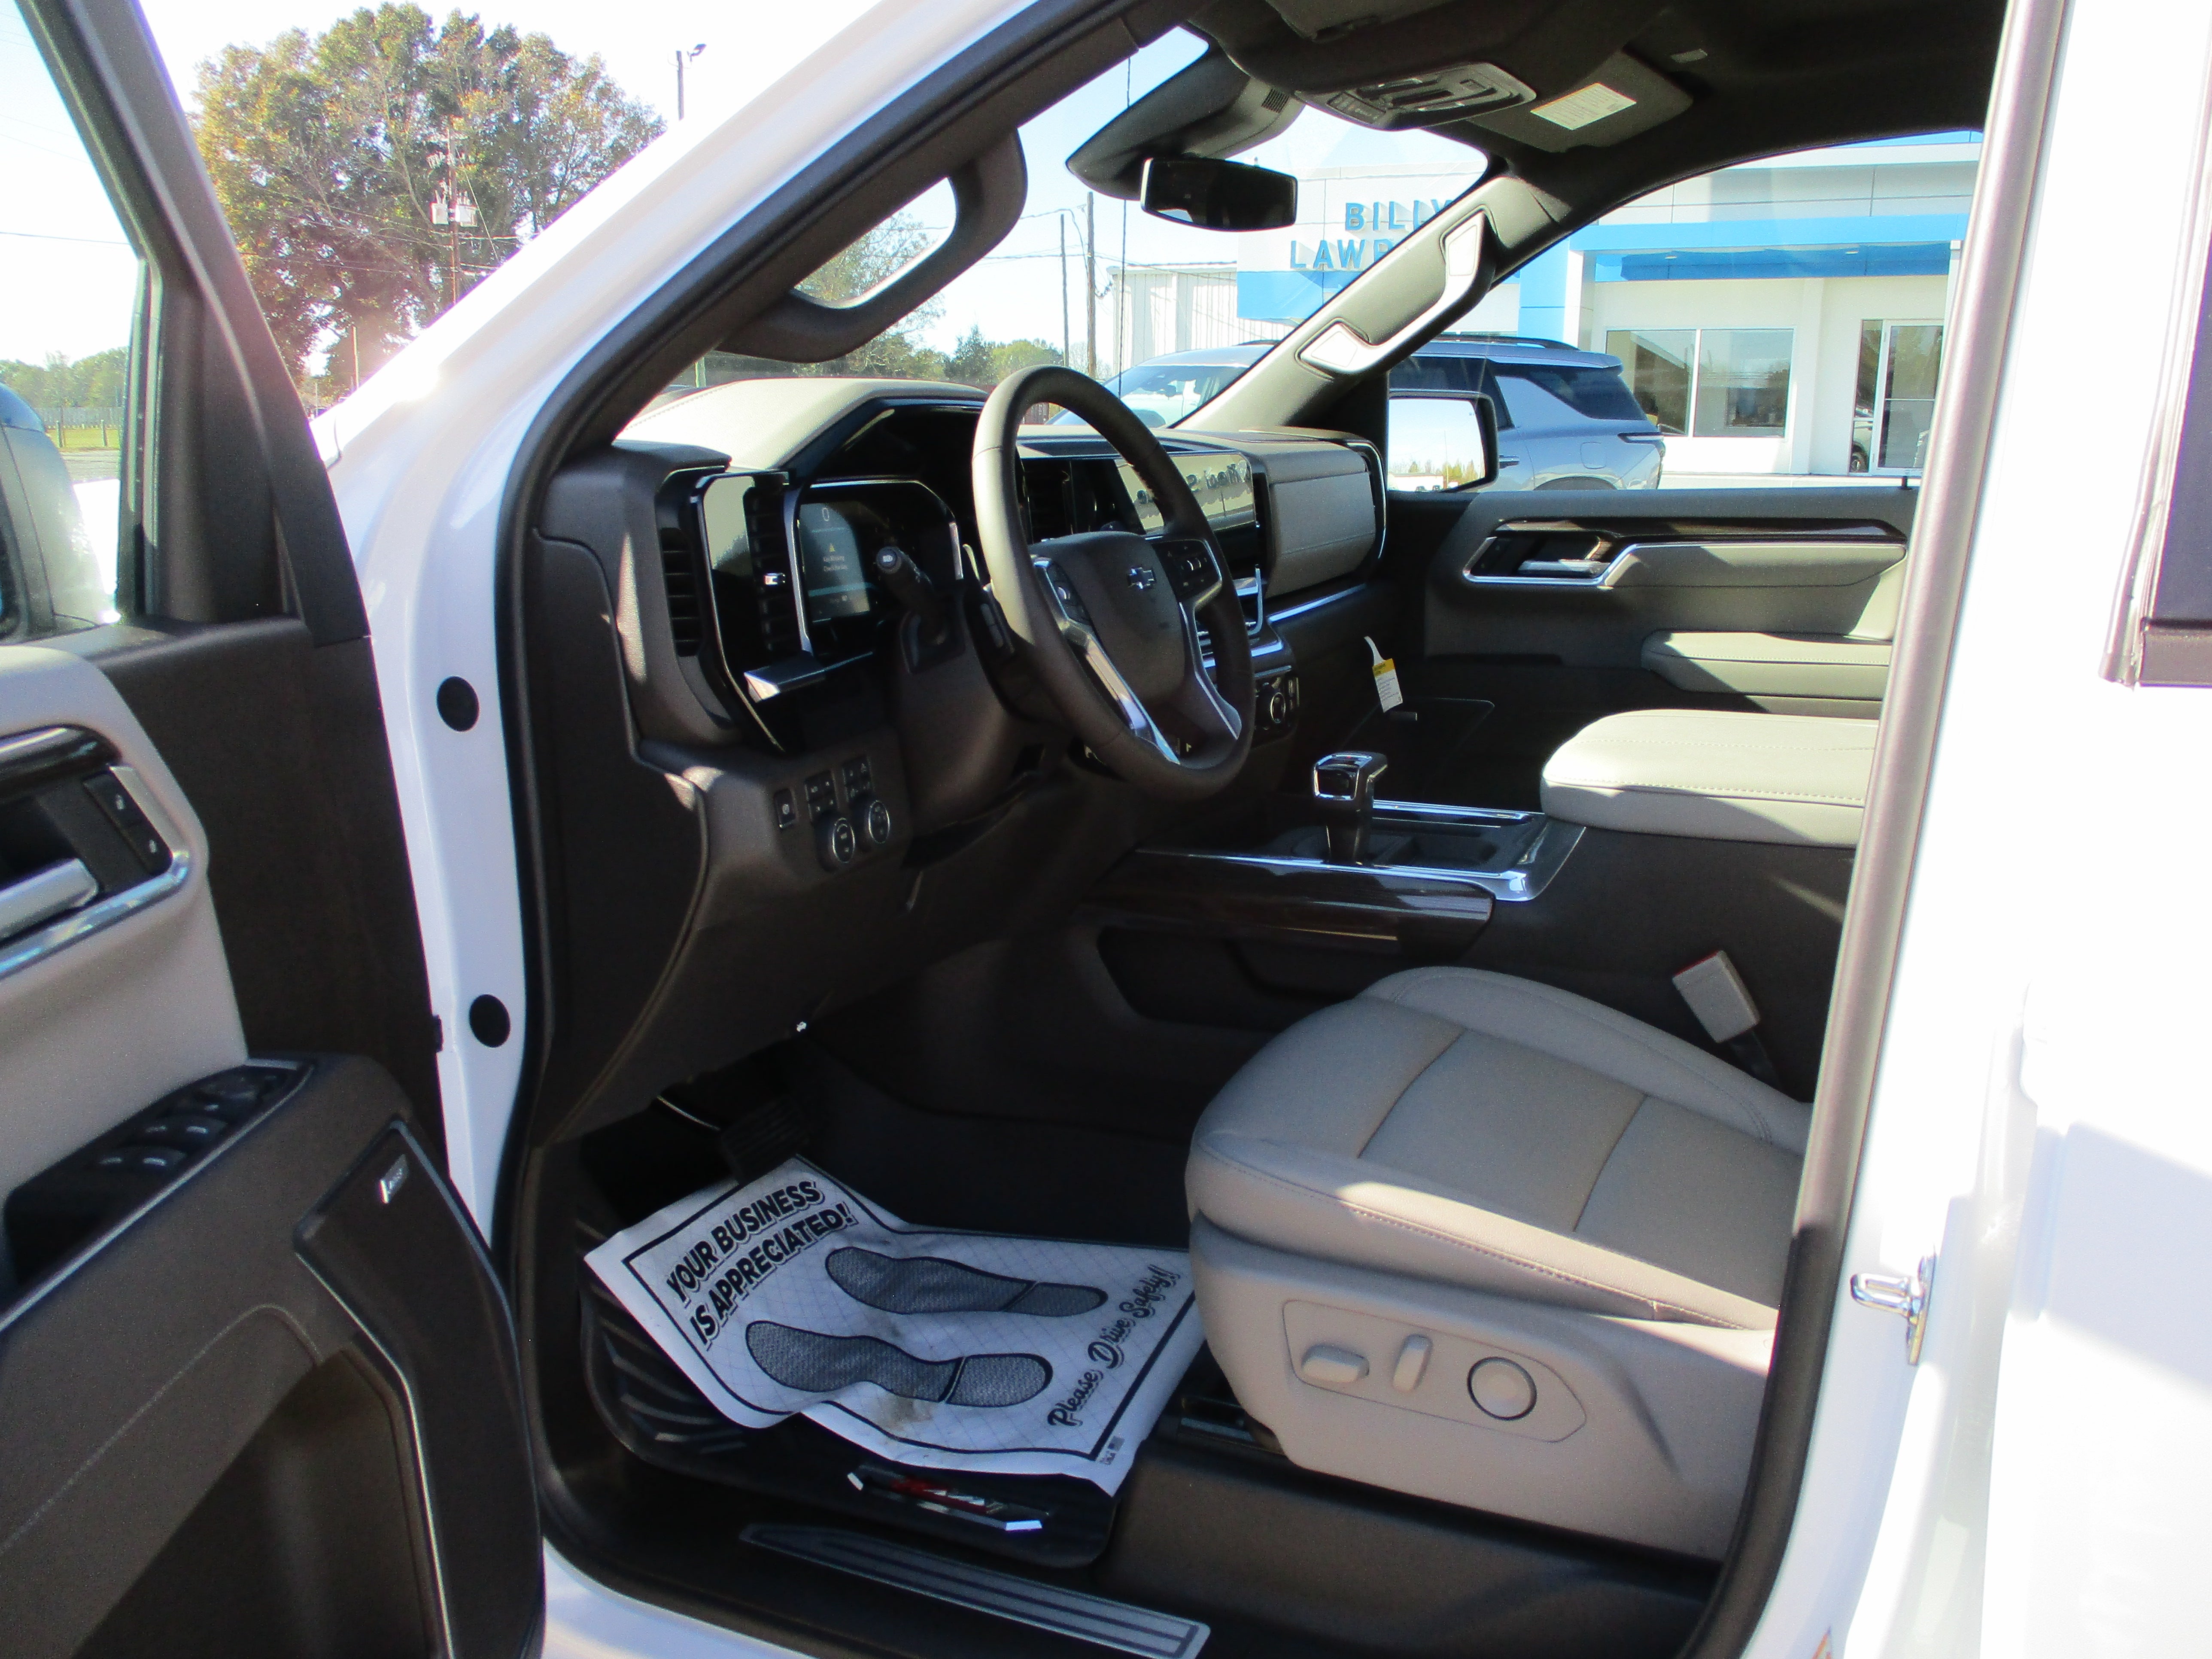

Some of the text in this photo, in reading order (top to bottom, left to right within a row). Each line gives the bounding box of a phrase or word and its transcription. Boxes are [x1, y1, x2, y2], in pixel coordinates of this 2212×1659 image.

[667, 1181, 824, 1307] YOUR BUSINESS
[690, 1203, 858, 1351] IS APPRECIATED!
[1047, 1369, 1103, 1426] Please
[1088, 1317, 1136, 1369] Drive
